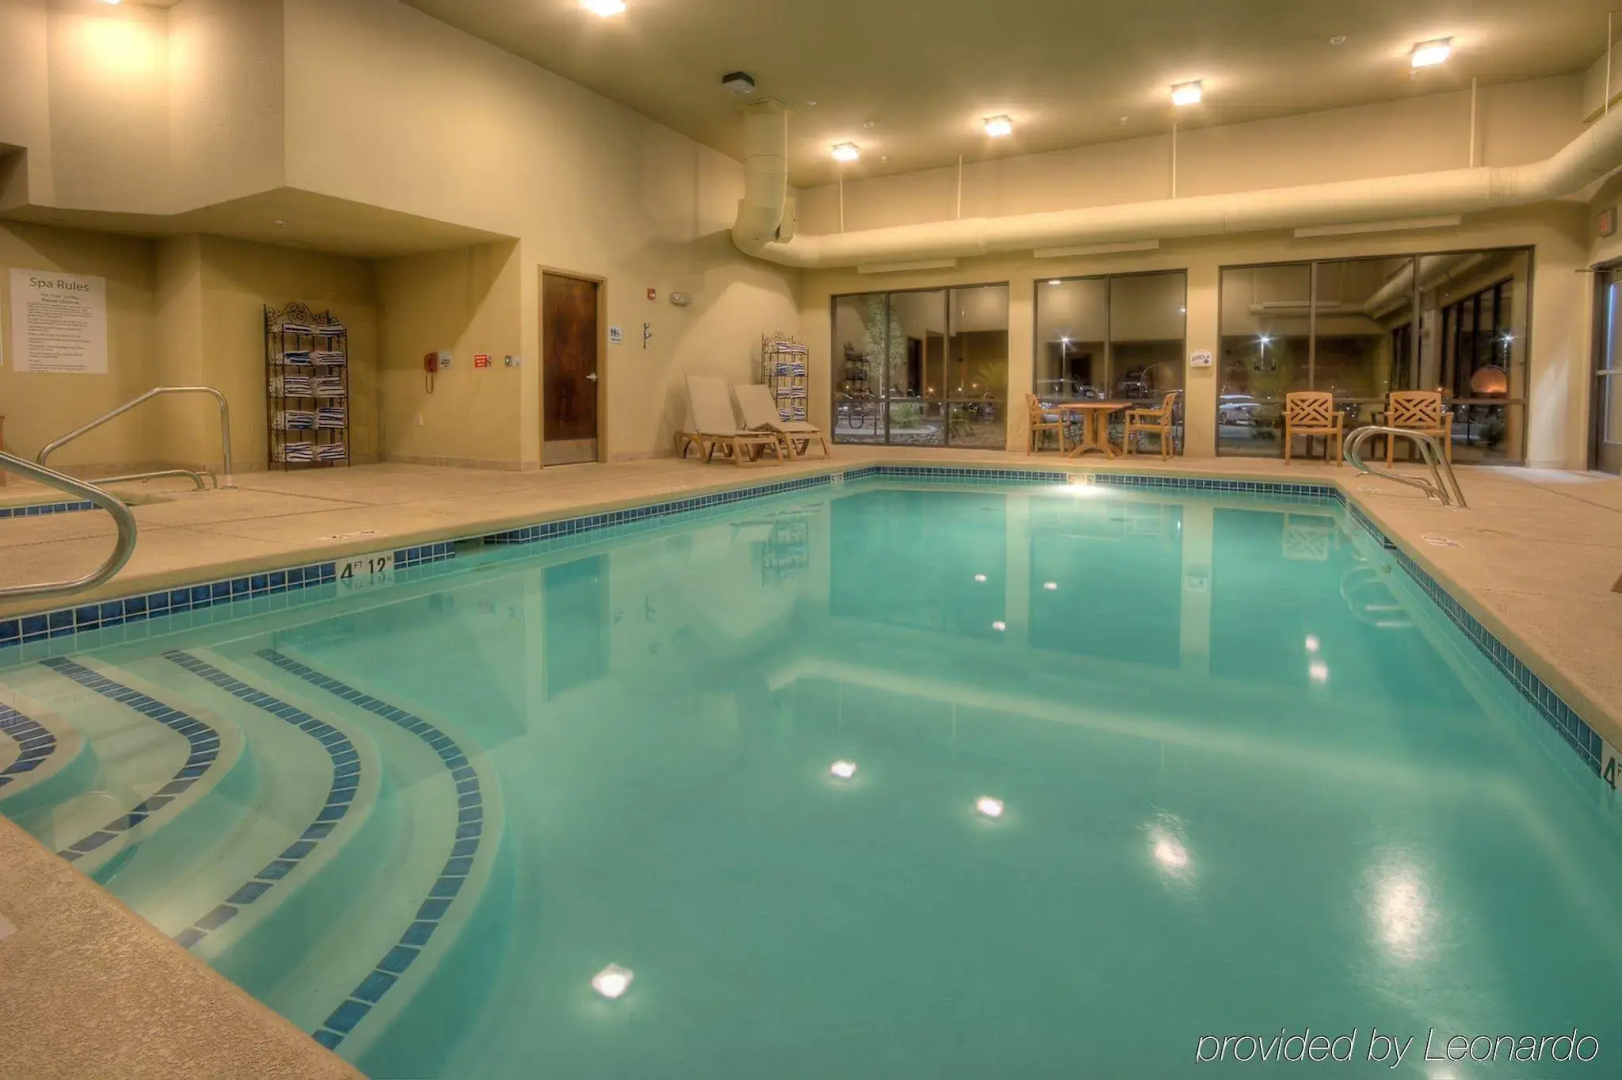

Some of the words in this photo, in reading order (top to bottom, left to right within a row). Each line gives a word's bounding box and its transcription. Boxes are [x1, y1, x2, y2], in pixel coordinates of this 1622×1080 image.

[29, 277, 54, 289] Spa
[57, 280, 90, 292] Rules
[340, 563, 355, 579] 4
[368, 557, 386, 574] 12
[1603, 756, 1616, 792] 4
